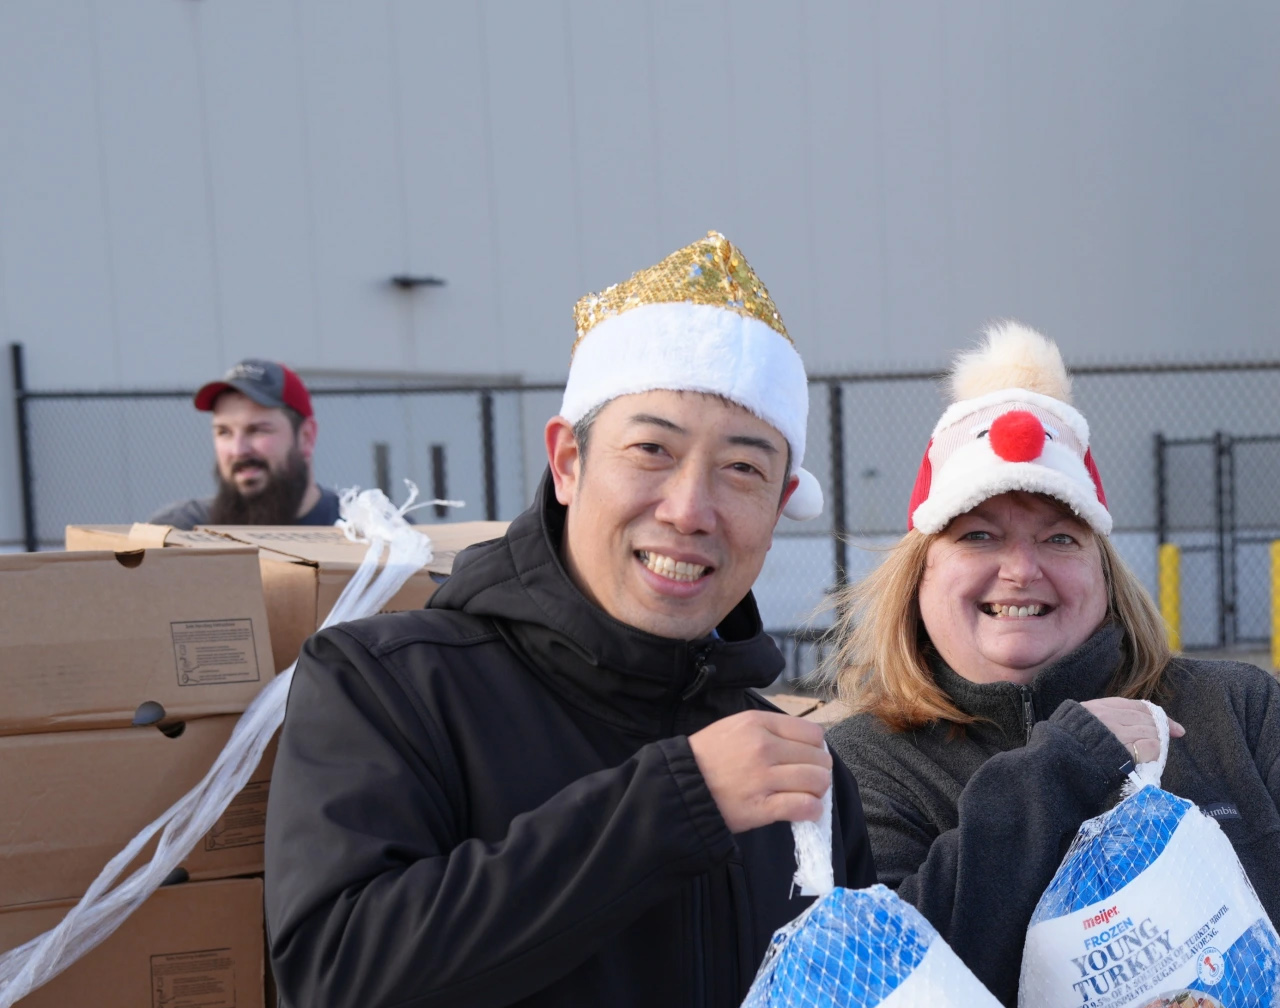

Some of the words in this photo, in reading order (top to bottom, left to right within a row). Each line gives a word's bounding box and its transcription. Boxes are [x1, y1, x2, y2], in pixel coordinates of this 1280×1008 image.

[1071, 917, 1159, 978] YOUNG
[1082, 905, 1120, 931] meijer
[1084, 917, 1134, 950] FROZEN
[1072, 929, 1175, 1002] TURKEY
[1111, 987, 1124, 1000] OF
[1125, 984, 1132, 992] A
[1184, 922, 1211, 948] TURKEY
